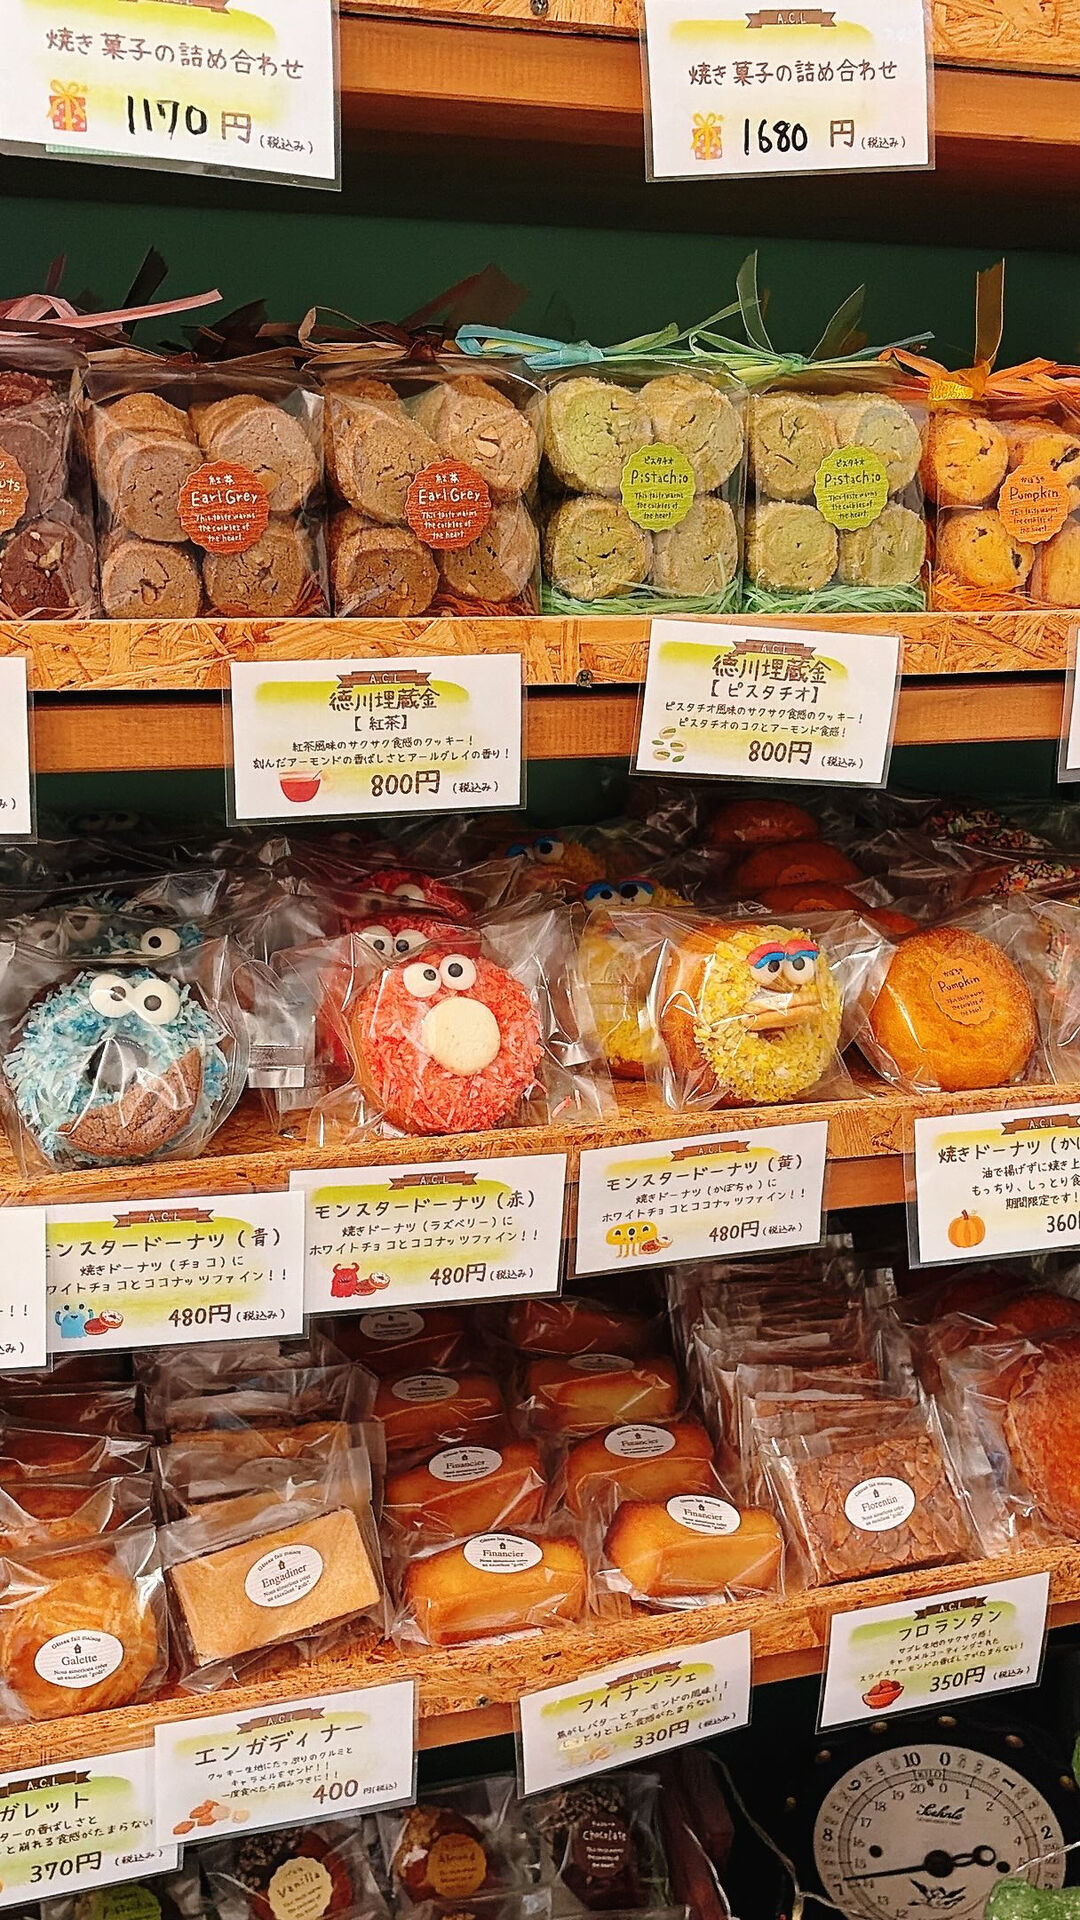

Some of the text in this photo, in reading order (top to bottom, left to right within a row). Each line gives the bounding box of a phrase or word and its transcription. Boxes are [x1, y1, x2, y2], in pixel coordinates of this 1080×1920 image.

[46, 28, 304, 79] 焼き菓子の詰め合わせ
[688, 59, 898, 86] 焼き菓子の詰め合わせ
[127, 95, 313, 154] 1170 円 （税込み）
[743, 118, 906, 155] 1680 円 （税込み）
[631, 469, 689, 485] Pistachio
[824, 470, 881, 488] Pistachio
[191, 489, 257, 507] Earl Grey
[419, 487, 480, 505] Earl Grey
[1009, 486, 1059, 502] Pumpkin
[712, 654, 831, 685] 徳川埋蔵金
[329, 688, 440, 712] 徳川埋蔵金
[711, 679, 819, 704] 【ピスタチオ】
[354, 714, 408, 731] 【紅茶】
[665, 700, 863, 724] ピスタチオ風味のサクサク食感のクッキー！
[678, 717, 847, 738] ピスタチオのコクとアーモンド食感！
[292, 735, 474, 752] 紅茶風味のサクサク食感のクッキー！
[749, 739, 864, 769] 800円 （税込み）
[253, 748, 510, 769] 刻んだアーモンドの香ばしさとアールグレイの香り！
[370, 769, 499, 798] 800円 （税込み）
[937, 976, 980, 993] Pumpkin
[607, 1154, 804, 1191] モンスタードーナツ（黄）
[636, 1178, 777, 1204] 焼きドーナツ（かぼちゃ）に
[1006, 1192, 1078, 1210] 期間限定です！
[315, 1190, 537, 1219] モンスタードーナツ（赤）
[602, 1188, 806, 1222] ホワイトチョコとココナッツファイン！！
[342, 1216, 513, 1237] 焼きドーナツ（ラズベリー）に
[709, 1220, 759, 1243] 480円
[310, 1229, 539, 1256] ホワイトチョコとココナッツファイン！！
[80, 1255, 244, 1277] 焼きドーナツ（チョコ）に
[430, 1263, 533, 1286] 480円 （税込み）
[168, 1304, 287, 1328] 480円 （税込み）
[446, 1460, 485, 1470] Financier
[684, 1508, 723, 1520] Financier
[861, 1495, 898, 1512] Florentin
[483, 1549, 524, 1558] Financier
[262, 1564, 307, 1588] Engadiner
[899, 1610, 1003, 1642] フロランタン
[61, 1654, 98, 1666] Galette
[929, 1666, 986, 1693] 350円
[579, 1672, 697, 1714] フィナンシェ
[633, 1719, 690, 1749] 330円
[195, 1723, 363, 1767] エンガディナー
[902, 1752, 921, 1768] 10
[940, 1752, 951, 1766] 0
[313, 1779, 359, 1804] 400
[847, 1780, 861, 1791] 9
[910, 1783, 926, 1794] 20
[939, 1783, 948, 1793] 0
[965, 1789, 970, 1800] 1
[1002, 1778, 1016, 1790] 1
[892, 1790, 905, 1800] 19
[0, 1792, 89, 1822] ガレット
[874, 1802, 887, 1812] 18
[986, 1802, 994, 1812] 2
[861, 1817, 872, 1828] 17
[1003, 1816, 1010, 1826] 3
[583, 1830, 626, 1841] Chocolate
[823, 1828, 833, 1841] 8
[1041, 1825, 1053, 1839] 2
[30, 1851, 102, 1884] 370円
[277, 1872, 320, 1898] Vanilla
[833, 1883, 844, 1896] 7
